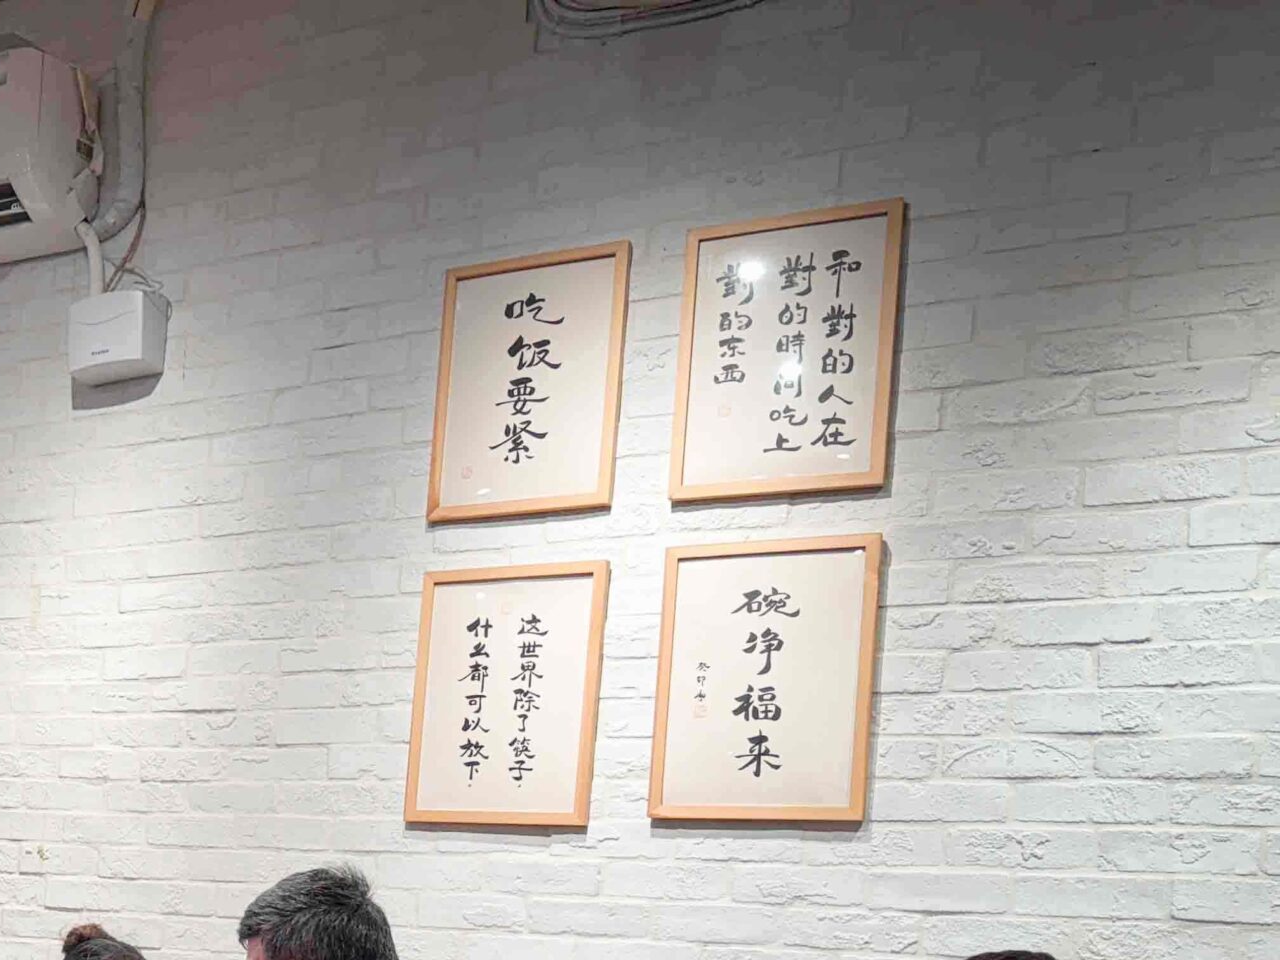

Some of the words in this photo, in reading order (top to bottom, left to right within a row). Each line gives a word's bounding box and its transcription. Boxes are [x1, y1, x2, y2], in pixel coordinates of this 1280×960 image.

[489, 292, 565, 464] 吃饭要紧
[811, 250, 862, 447] 和對的人在
